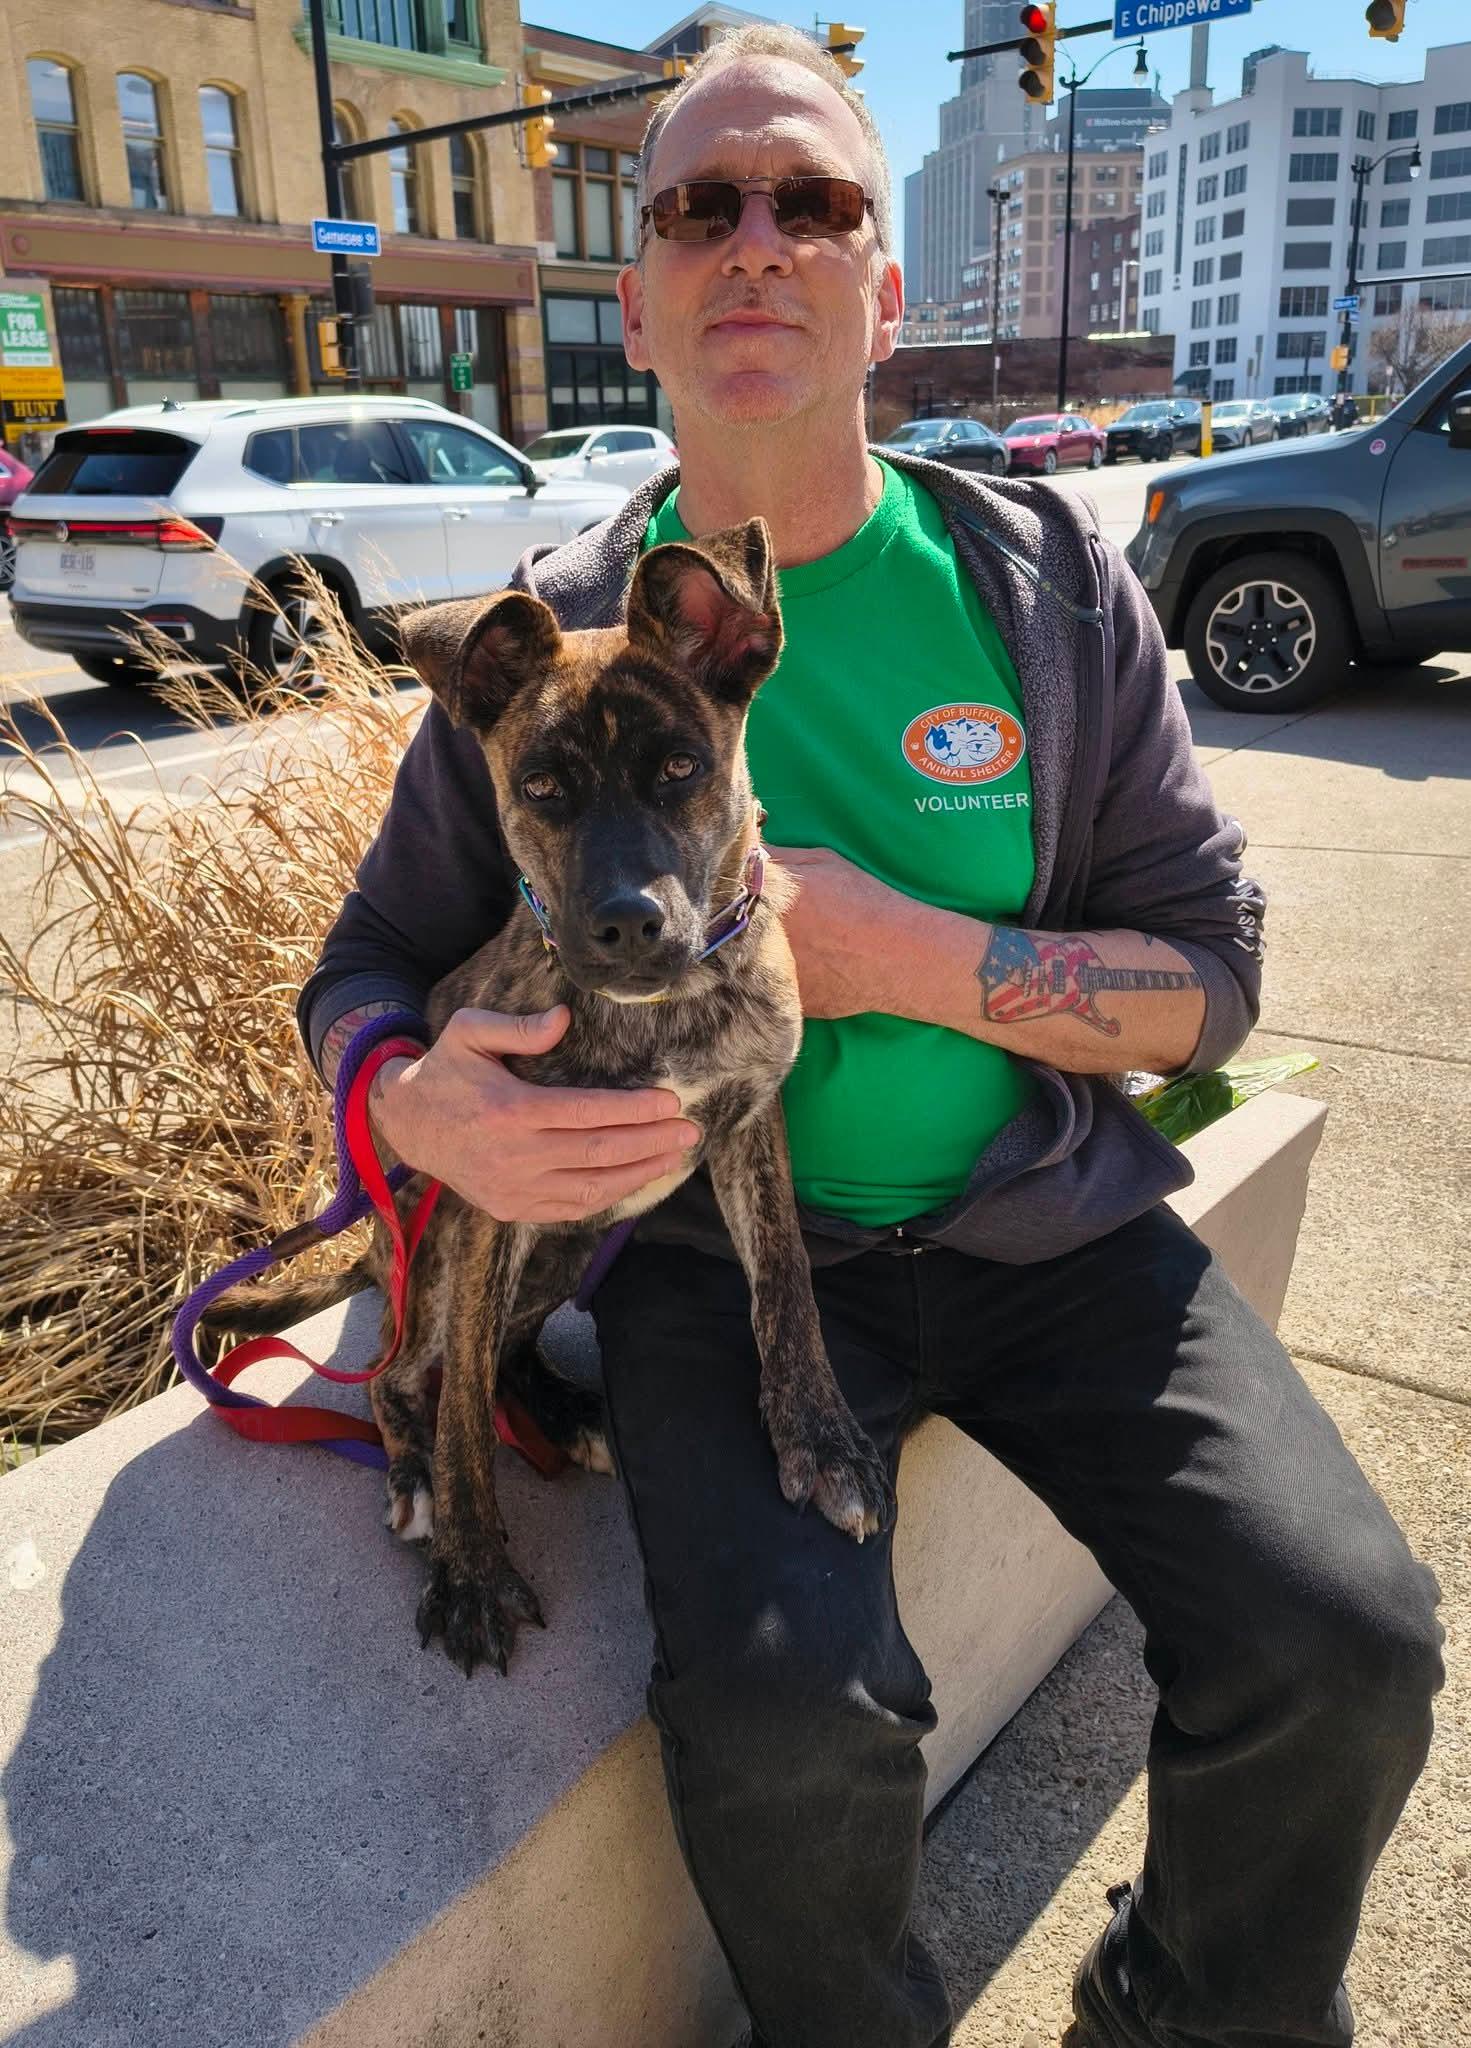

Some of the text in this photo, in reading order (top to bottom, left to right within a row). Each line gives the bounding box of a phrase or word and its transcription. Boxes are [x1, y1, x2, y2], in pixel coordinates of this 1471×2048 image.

[1121, 0, 1221, 28] E Chippewa
[7, 312, 37, 330] FOR
[2, 330, 49, 348] LEASE
[13, 401, 57, 417] HUNT
[919, 707, 1003, 729] CITY OF BUFFALO
[918, 750, 1014, 778] ANIMAL SHELTER
[914, 792, 1030, 813] VOLUNTEER
